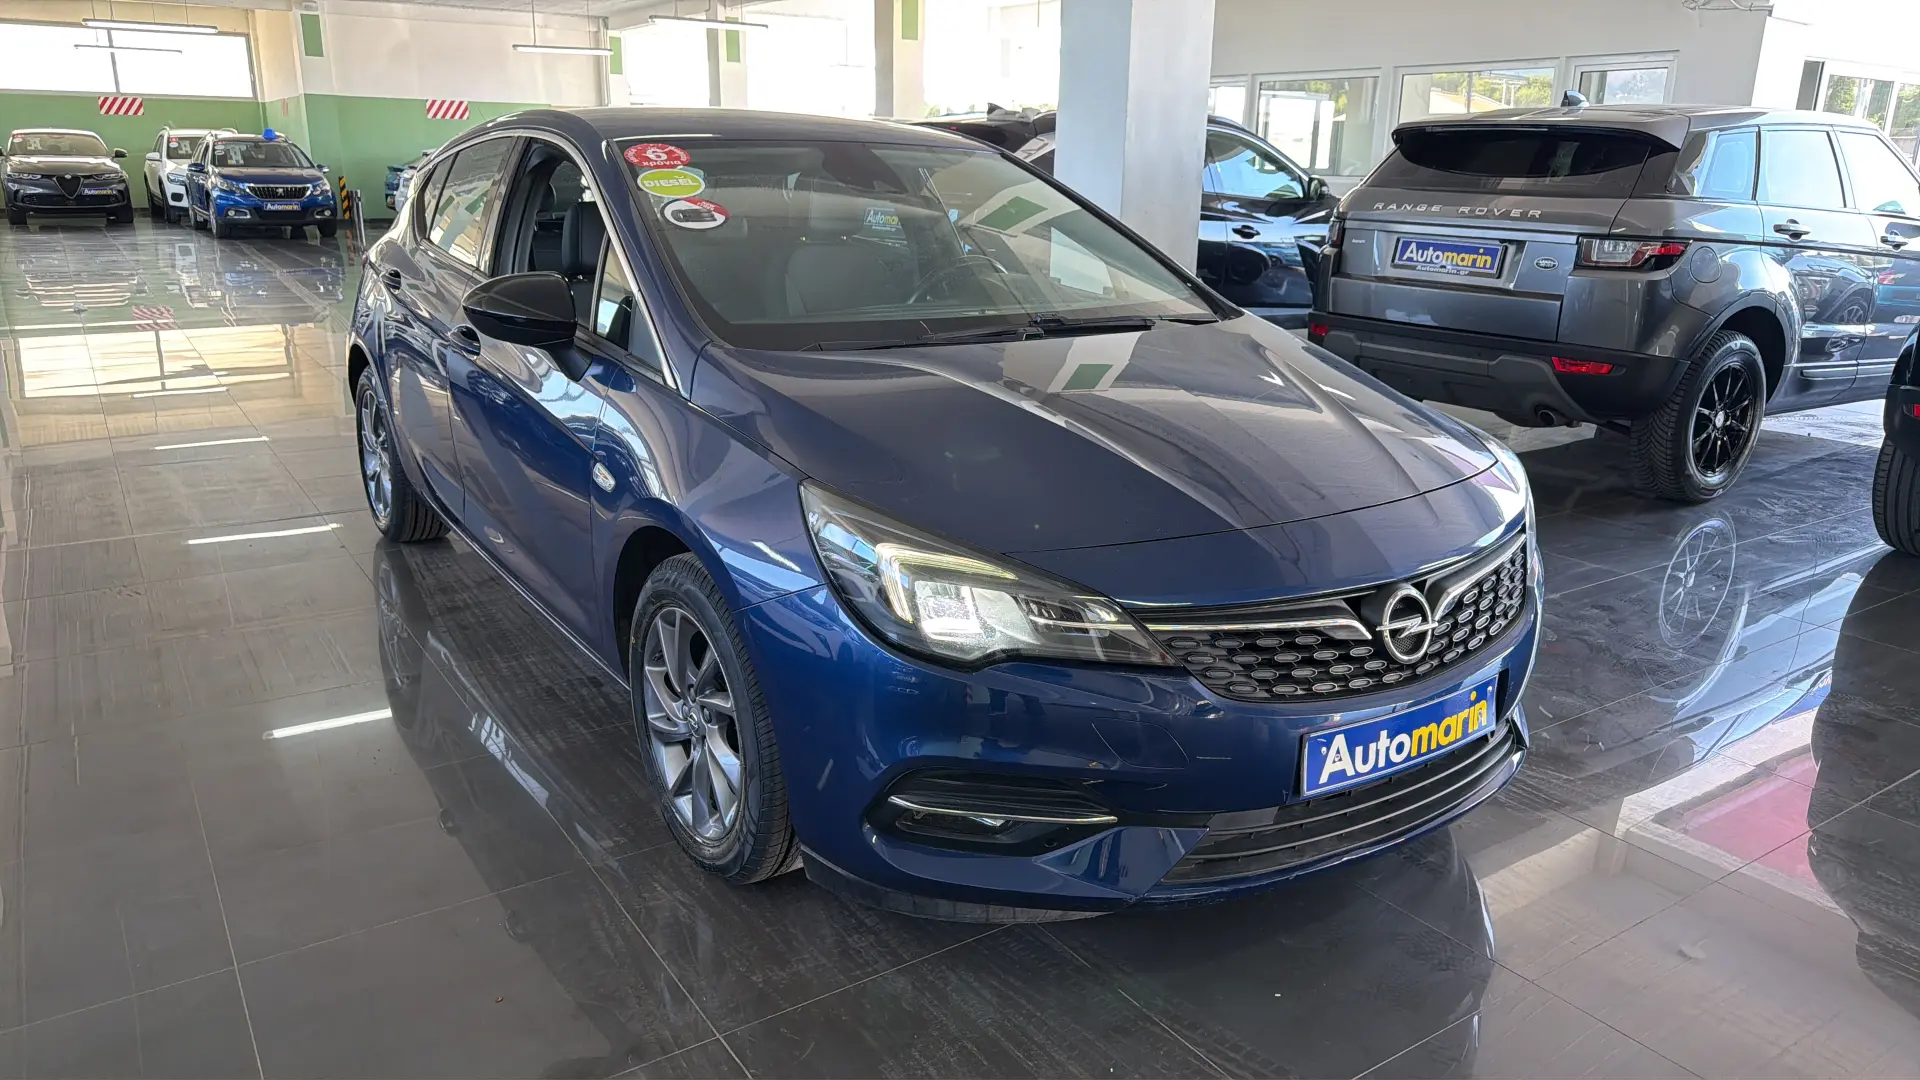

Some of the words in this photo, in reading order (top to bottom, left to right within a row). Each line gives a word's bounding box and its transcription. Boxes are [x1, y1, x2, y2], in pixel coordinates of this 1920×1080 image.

[866, 209, 899, 225] Automar
[1373, 202, 1443, 212] RANGE
[1457, 206, 1543, 218] ROVER
[1402, 242, 1492, 268] Automarin
[1416, 265, 1470, 275] Automarin.gr
[1318, 691, 1487, 785] Automarin
